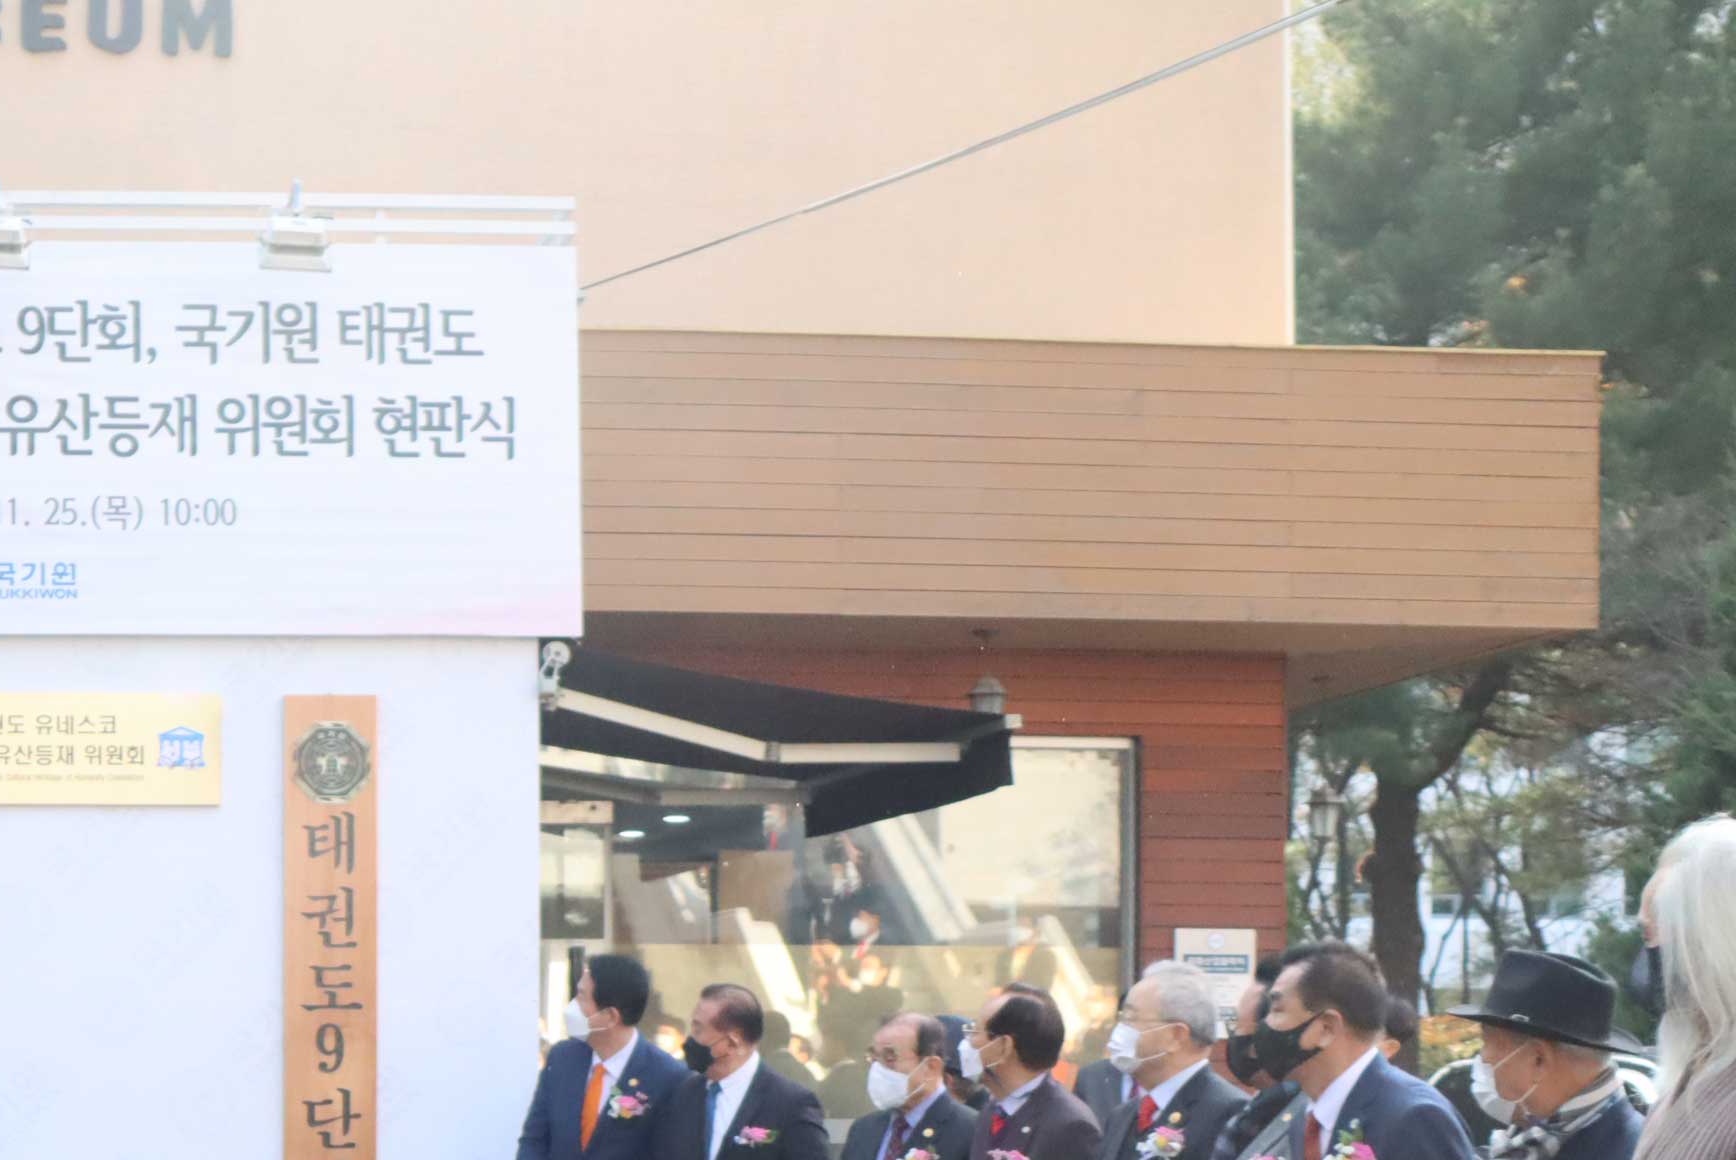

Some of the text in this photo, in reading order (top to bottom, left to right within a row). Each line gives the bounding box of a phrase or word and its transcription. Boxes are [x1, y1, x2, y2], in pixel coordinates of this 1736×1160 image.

[17, 300, 156, 363] 9단회,
[176, 301, 319, 364] 국기원
[338, 302, 484, 364] 태권도
[215, 394, 354, 457] 위원회
[373, 396, 514, 460] 현판식
[44, 496, 144, 531] 25.(목)
[161, 497, 238, 527] 10:00
[35, 714, 117, 736] 유네스코
[84, 744, 145, 766] 위원회
